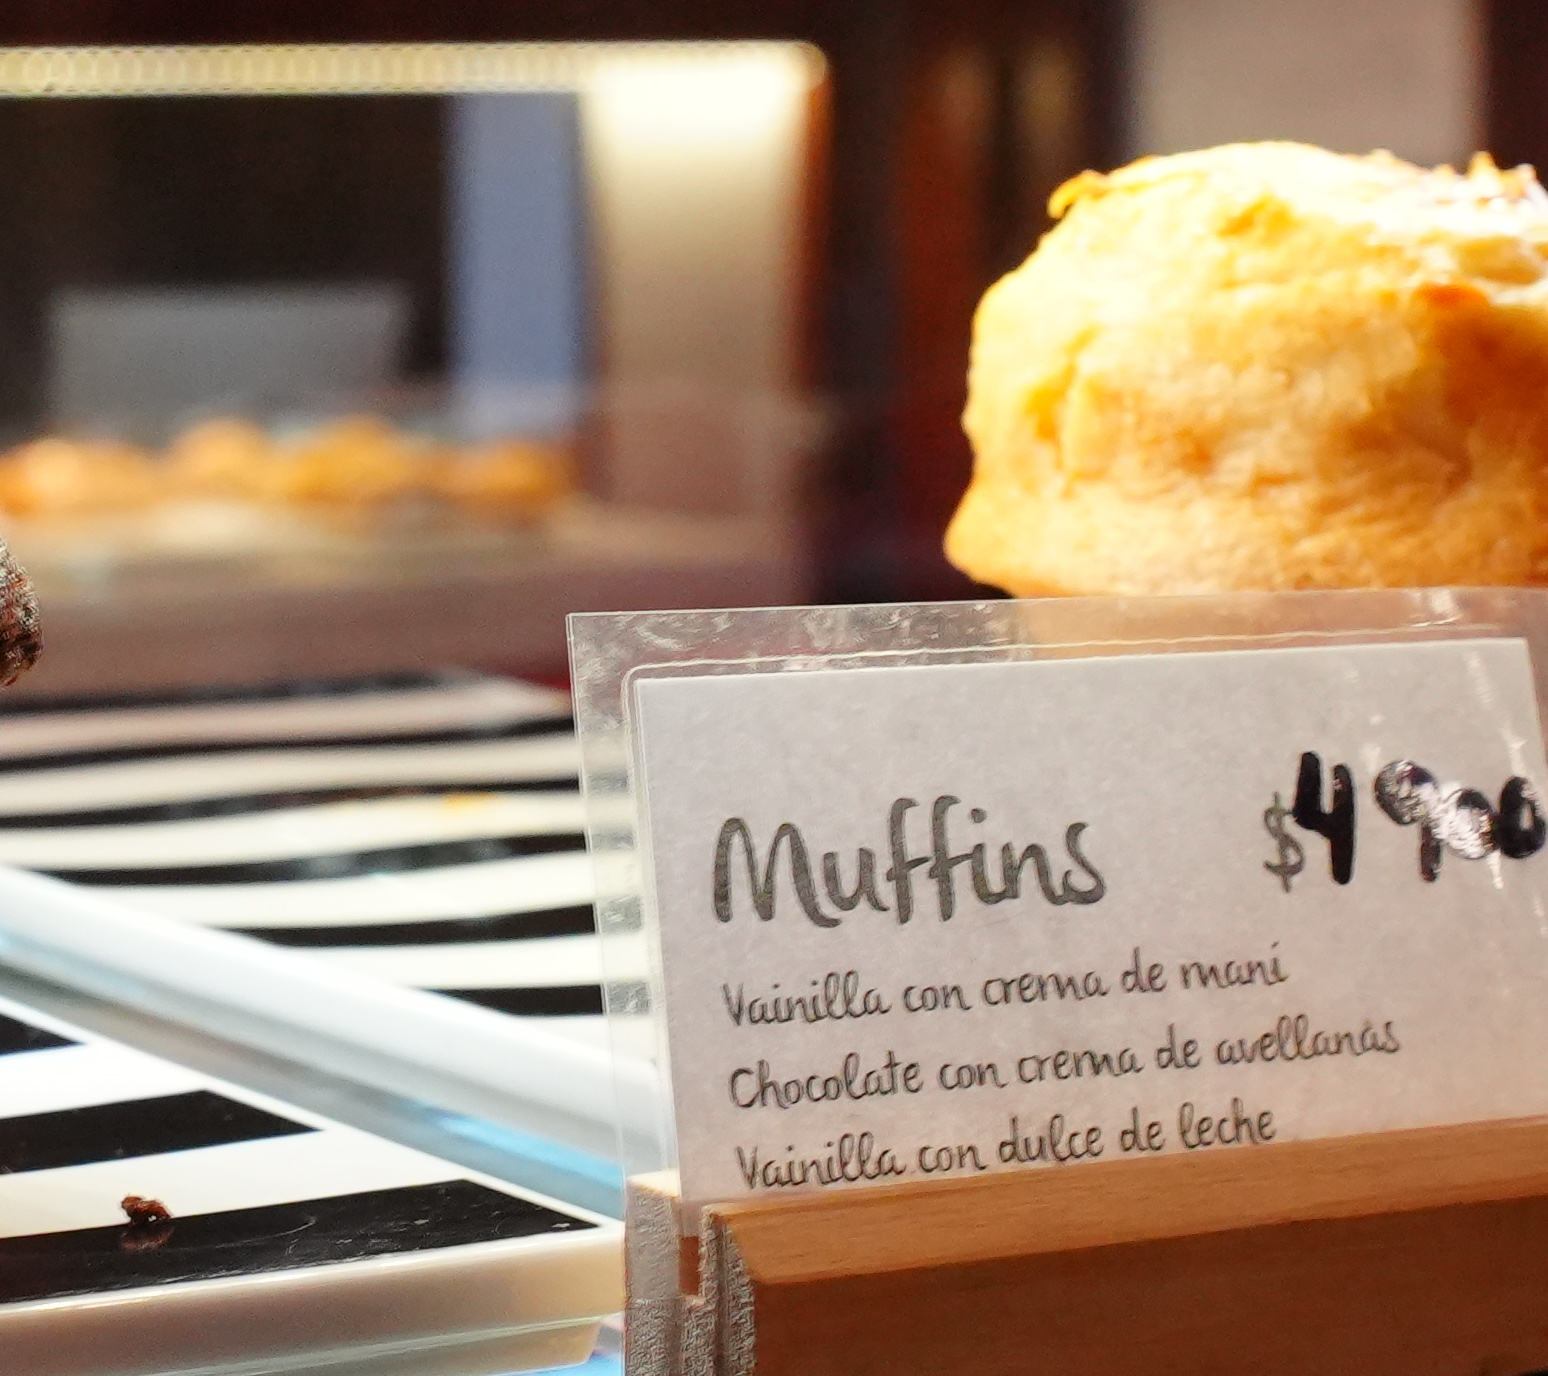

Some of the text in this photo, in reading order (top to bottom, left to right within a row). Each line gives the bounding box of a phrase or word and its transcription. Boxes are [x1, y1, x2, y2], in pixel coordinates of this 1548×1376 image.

[714, 795, 1105, 928] Muffins
[723, 970, 892, 1026] Vainilla
[903, 982, 972, 1012] con
[982, 970, 1110, 1007] crema
[1121, 946, 1167, 993] de
[729, 1013, 1400, 1109] Chocolate con crema de avellanas
[735, 1097, 1277, 1189] Vainilla con dulce de leche
